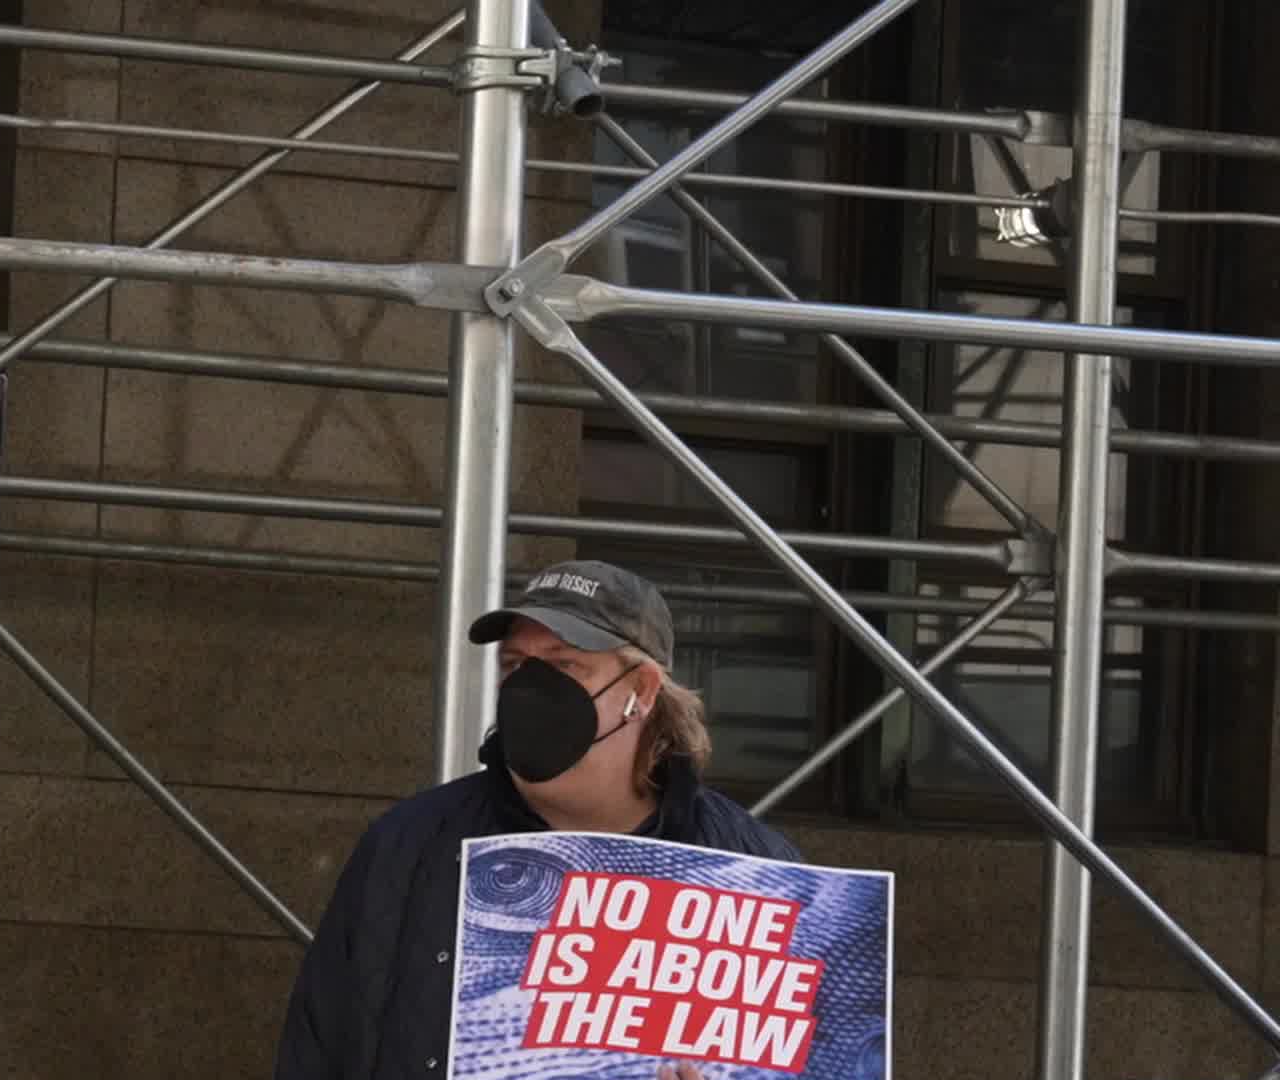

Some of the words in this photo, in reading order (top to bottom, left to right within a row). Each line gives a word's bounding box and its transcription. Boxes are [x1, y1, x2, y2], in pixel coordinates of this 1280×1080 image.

[559, 573, 600, 598] RESIST
[557, 876, 651, 932] NO
[667, 889, 792, 953] ONE
[527, 933, 595, 985] IS
[609, 940, 818, 1013] ABOVE
[535, 991, 650, 1049] THE
[663, 1000, 812, 1068] LAW
